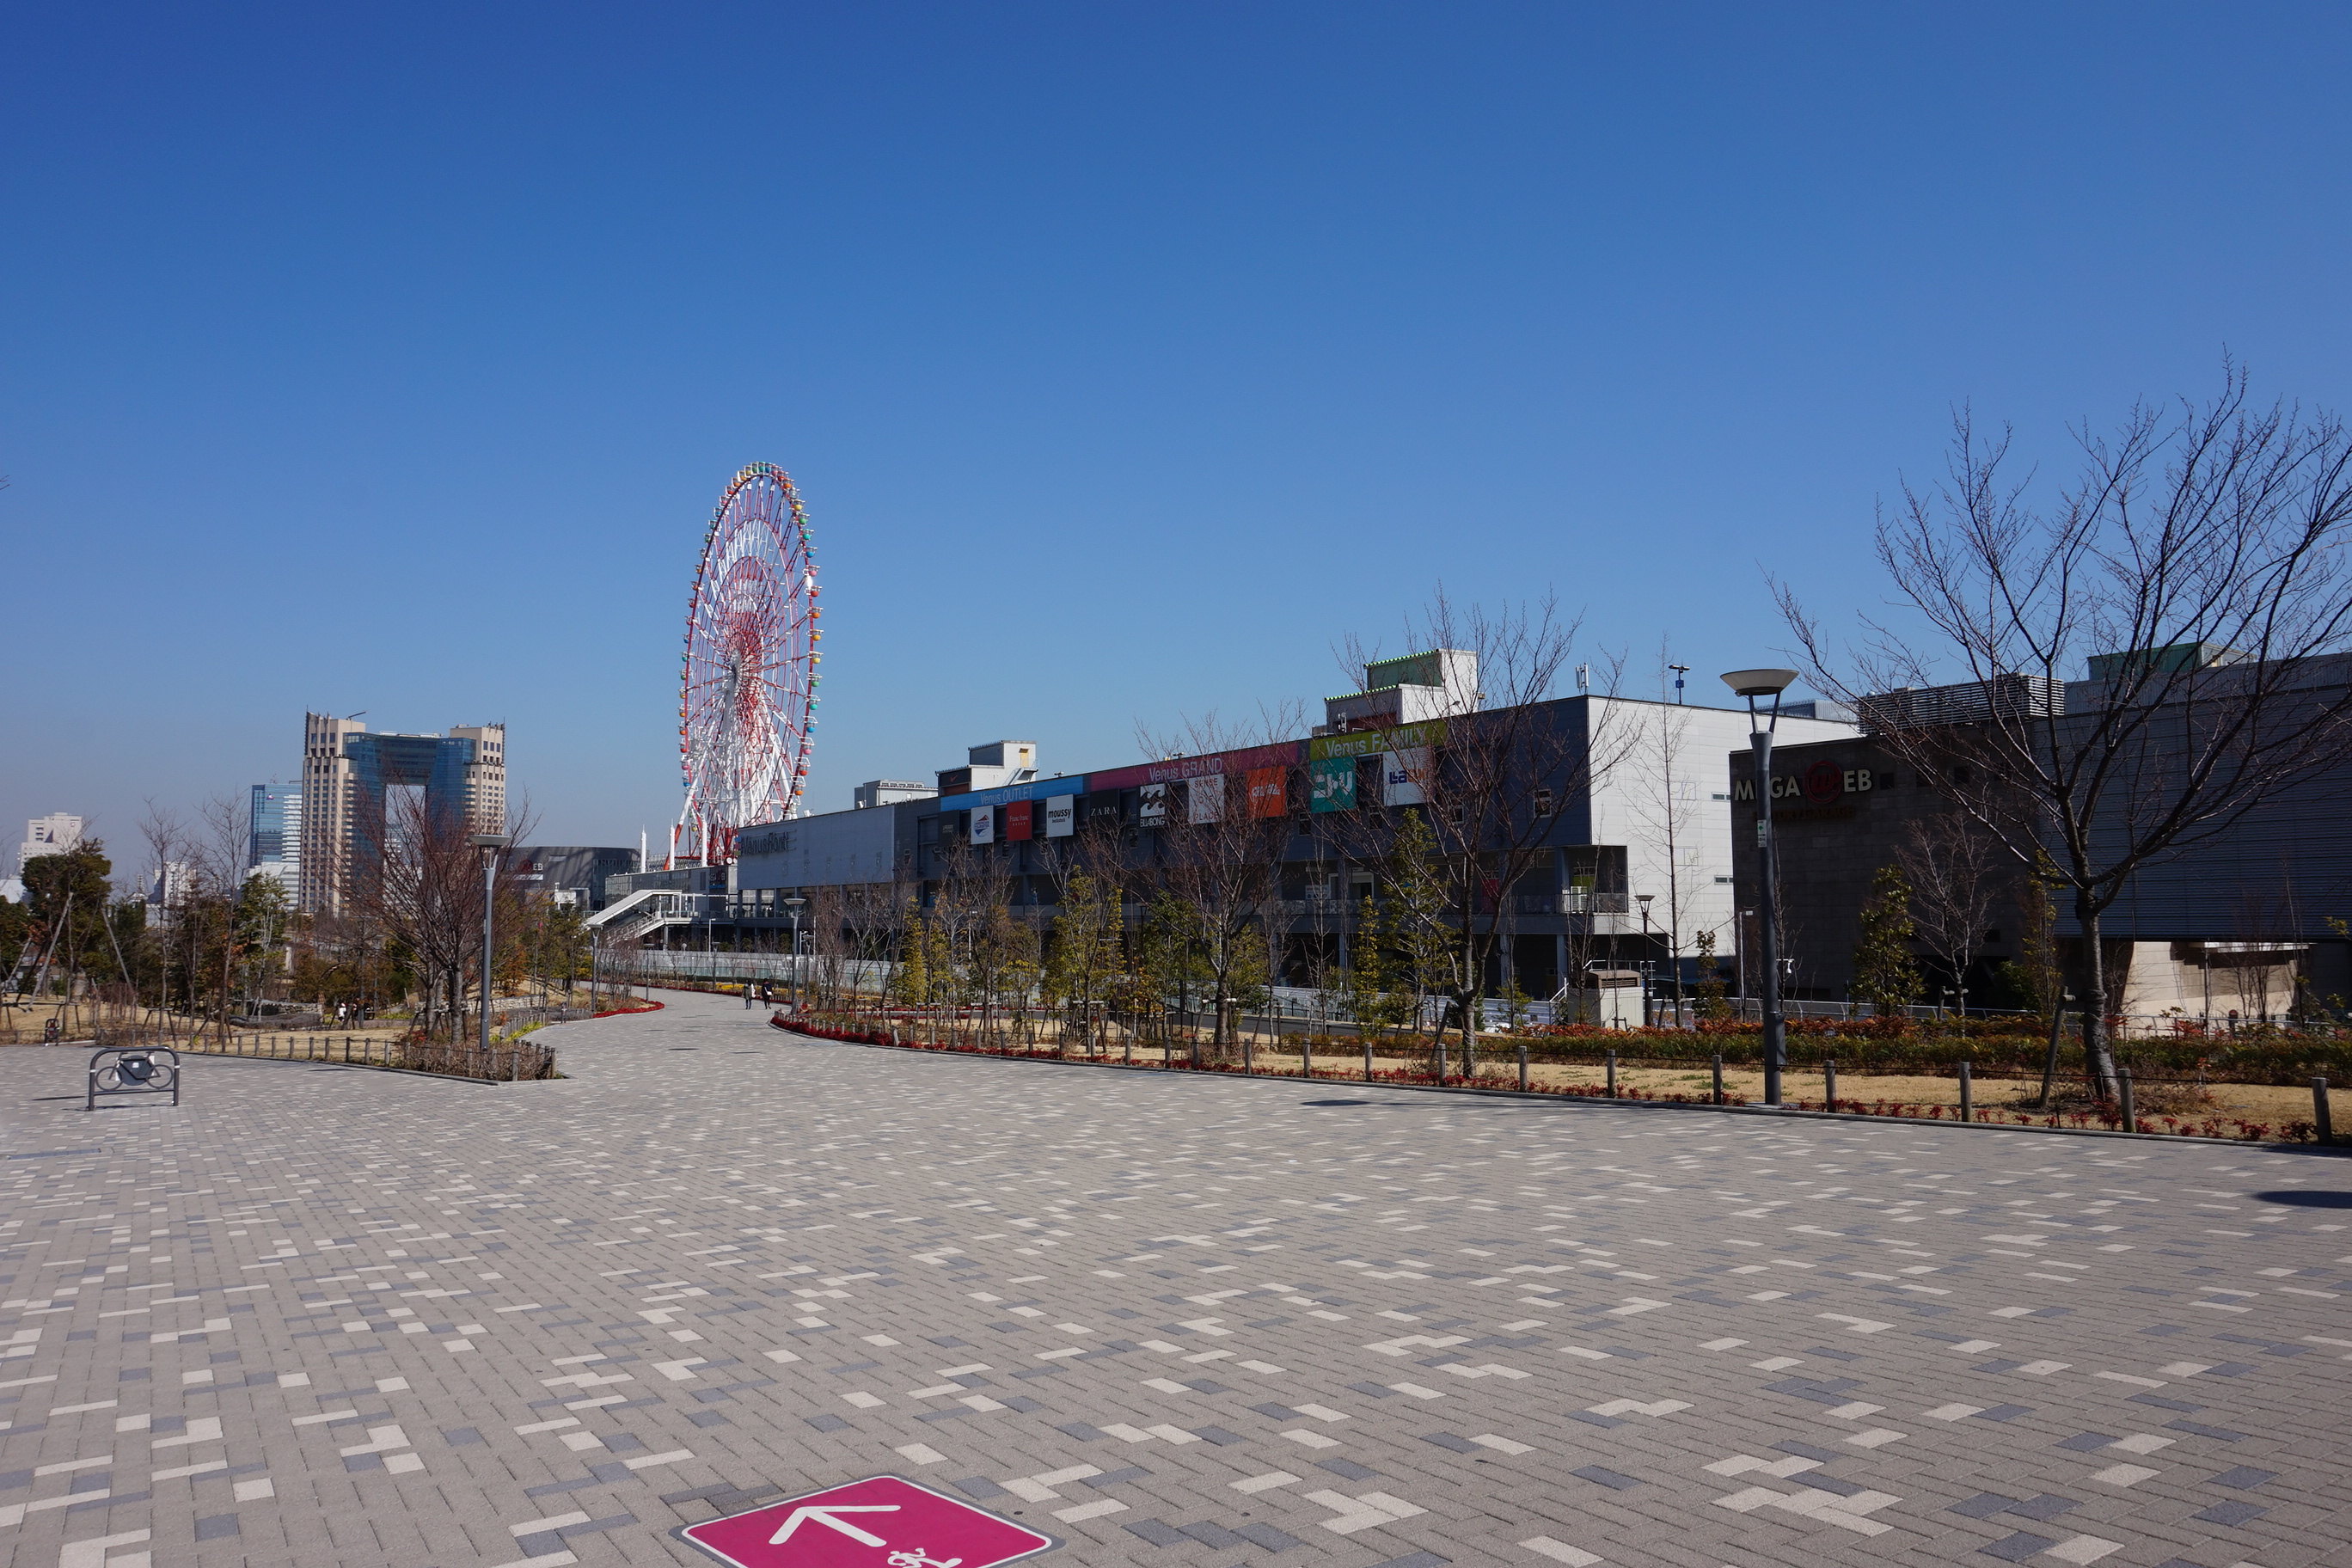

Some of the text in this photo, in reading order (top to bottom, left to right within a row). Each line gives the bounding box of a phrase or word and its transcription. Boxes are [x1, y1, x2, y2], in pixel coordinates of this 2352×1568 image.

[1325, 726, 1428, 757] Venus FAMILY
[1148, 757, 1223, 781] Venus GRAND
[980, 786, 1033, 805] Venus OUTLET
[1734, 776, 1801, 801] MGA
[1048, 808, 1072, 819] moussy
[1090, 806, 1117, 816] ZARA
[1140, 817, 1166, 828] BILLABONG
